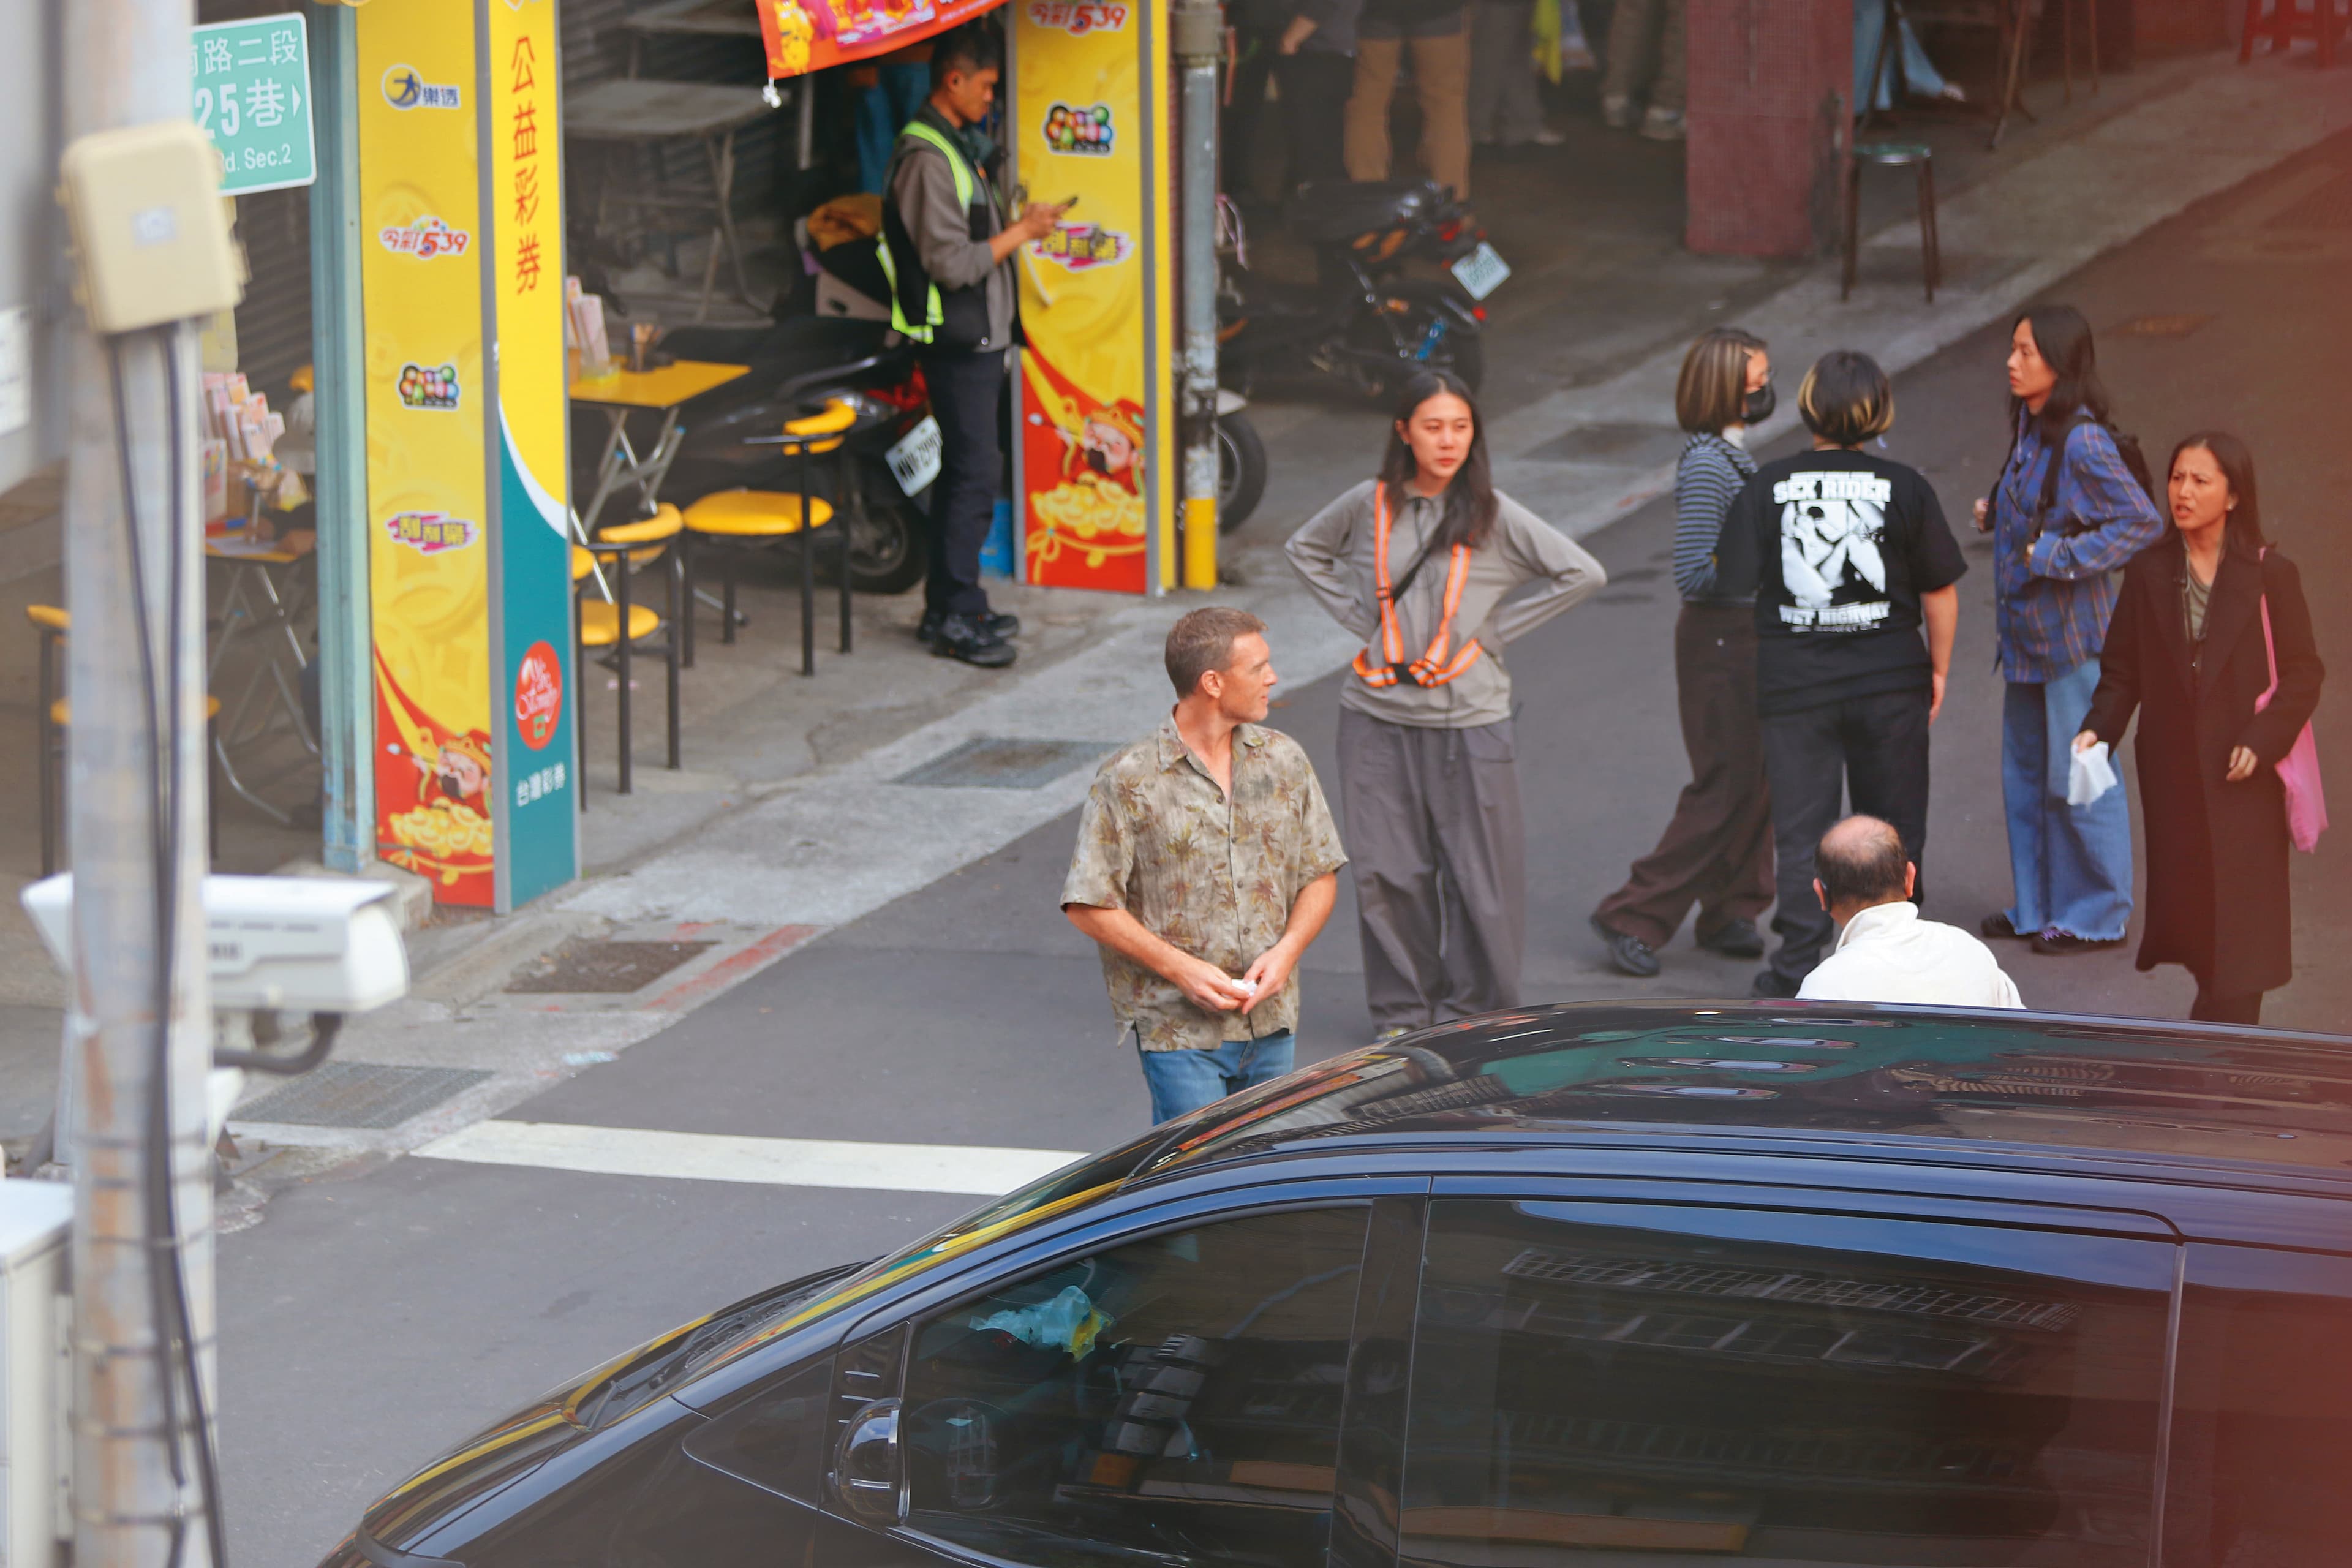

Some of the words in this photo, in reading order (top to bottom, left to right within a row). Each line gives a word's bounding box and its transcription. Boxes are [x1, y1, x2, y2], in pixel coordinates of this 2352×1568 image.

[244, 143, 292, 170] Sec.2
[511, 35, 540, 295] 公益彩券
[1773, 480, 1818, 505] SEX
[1821, 478, 1891, 502] RIDER
